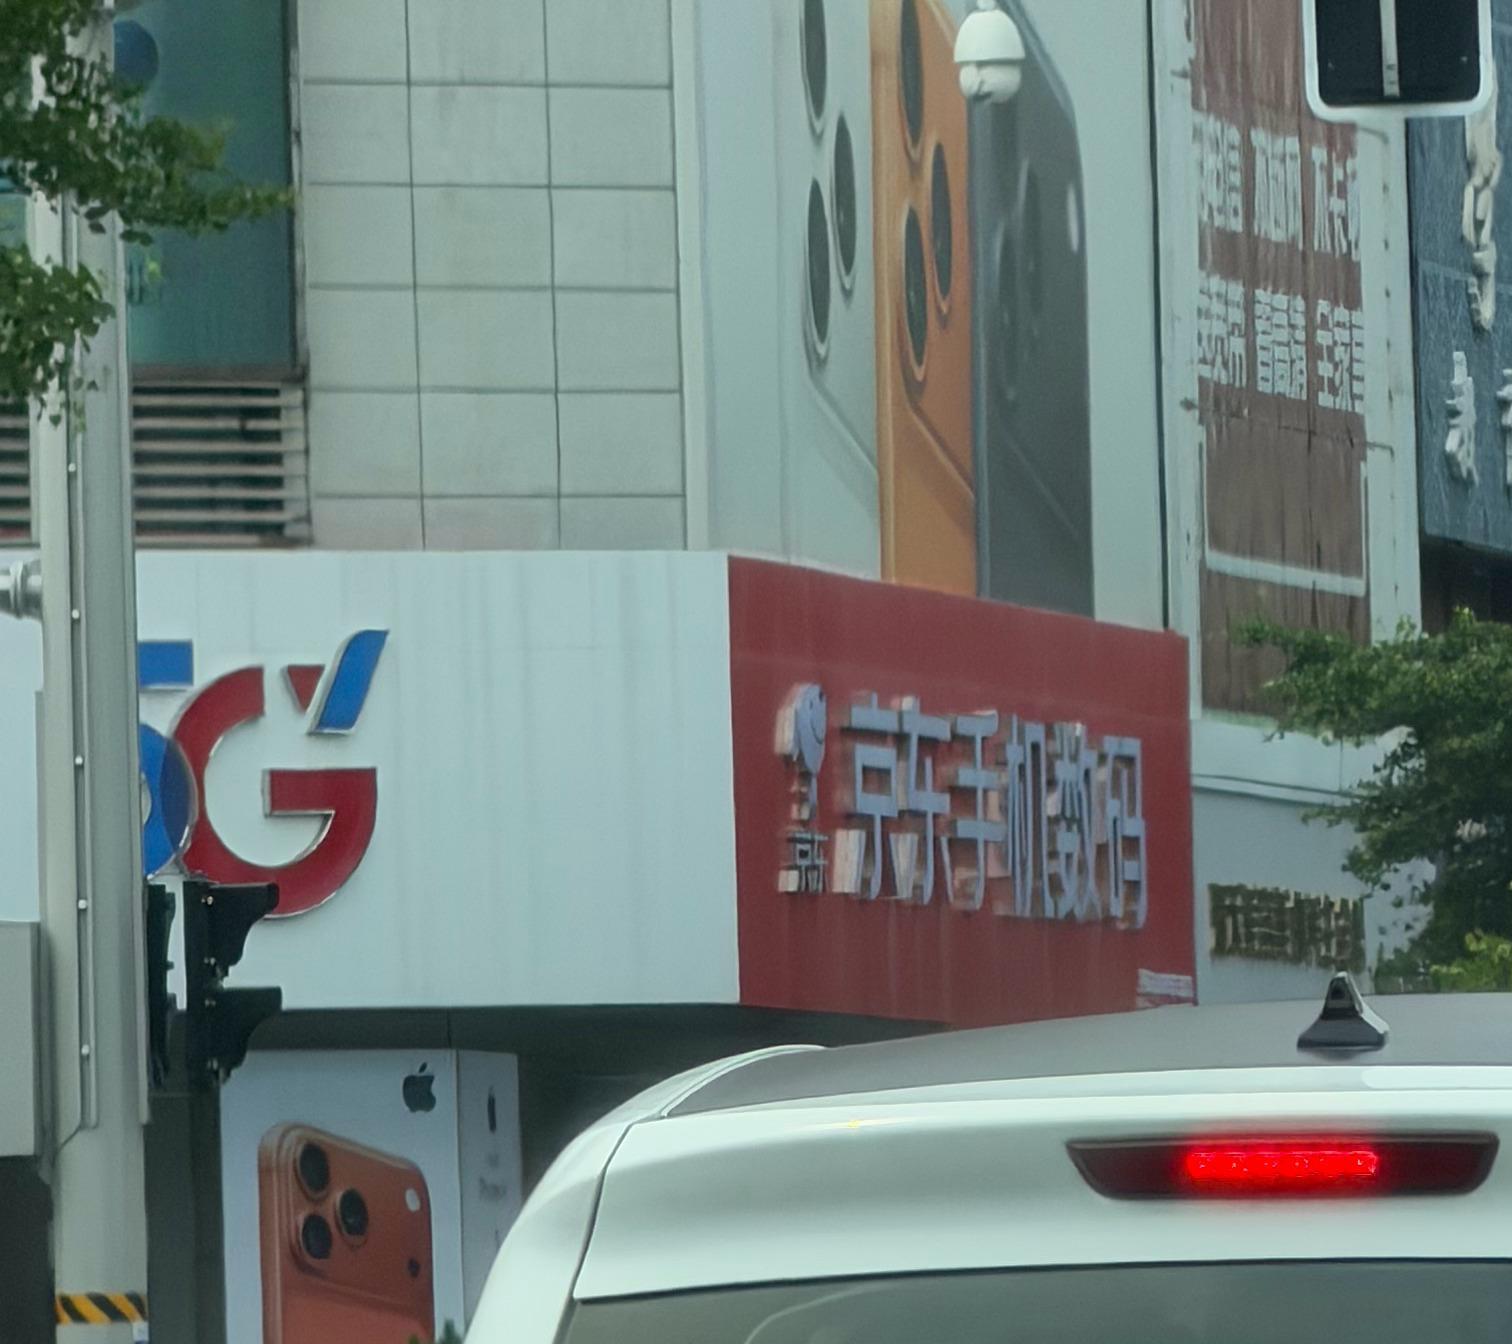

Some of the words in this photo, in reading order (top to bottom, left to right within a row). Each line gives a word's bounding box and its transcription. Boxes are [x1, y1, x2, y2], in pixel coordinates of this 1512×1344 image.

[835, 691, 1147, 929] 京东手机数码
